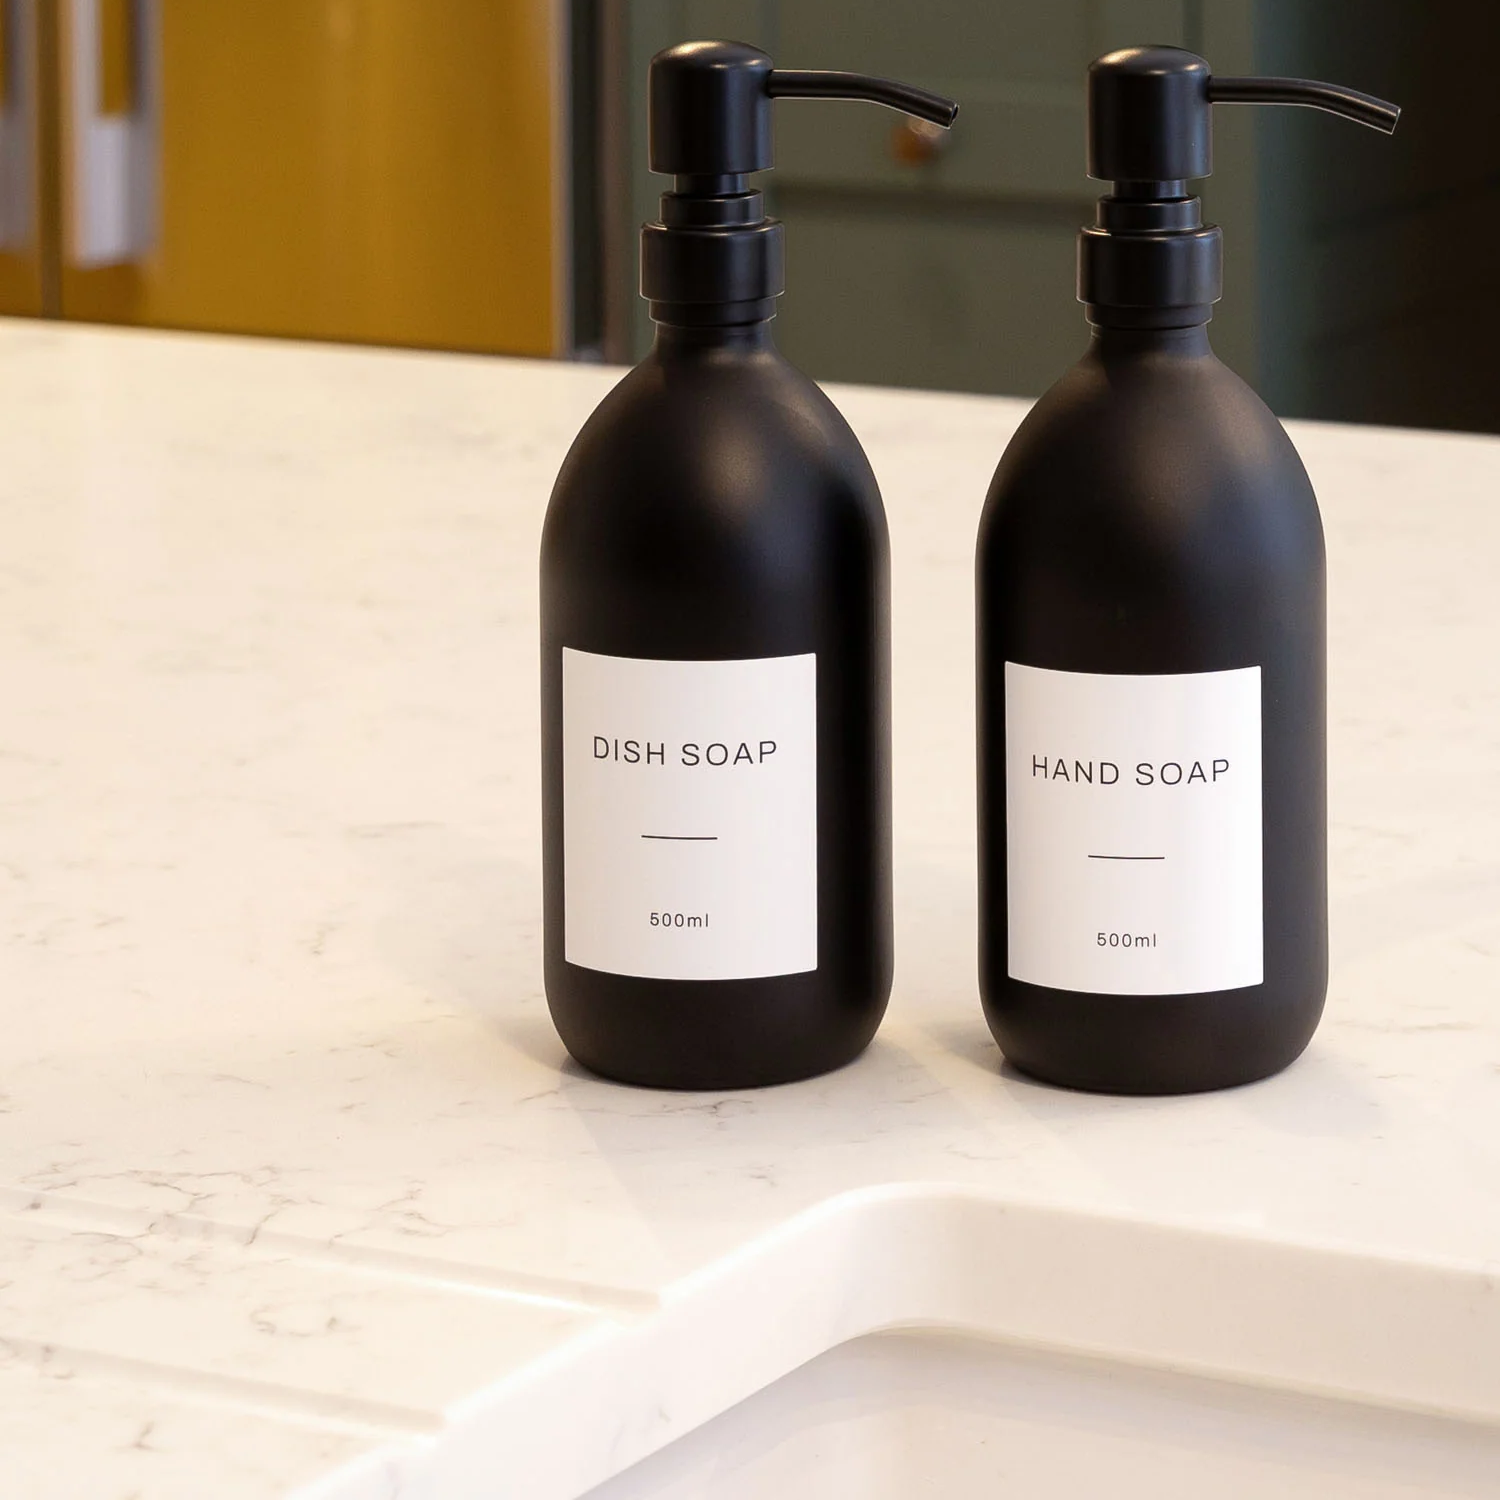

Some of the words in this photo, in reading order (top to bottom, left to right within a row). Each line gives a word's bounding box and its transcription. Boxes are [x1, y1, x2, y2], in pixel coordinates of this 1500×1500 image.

[592, 735, 666, 766] DISH
[681, 740, 778, 767] SOAP
[1032, 754, 1120, 785] HAND
[1135, 758, 1230, 786] SOAP
[649, 912, 710, 928] 500ml
[1097, 932, 1157, 948] 500ml
